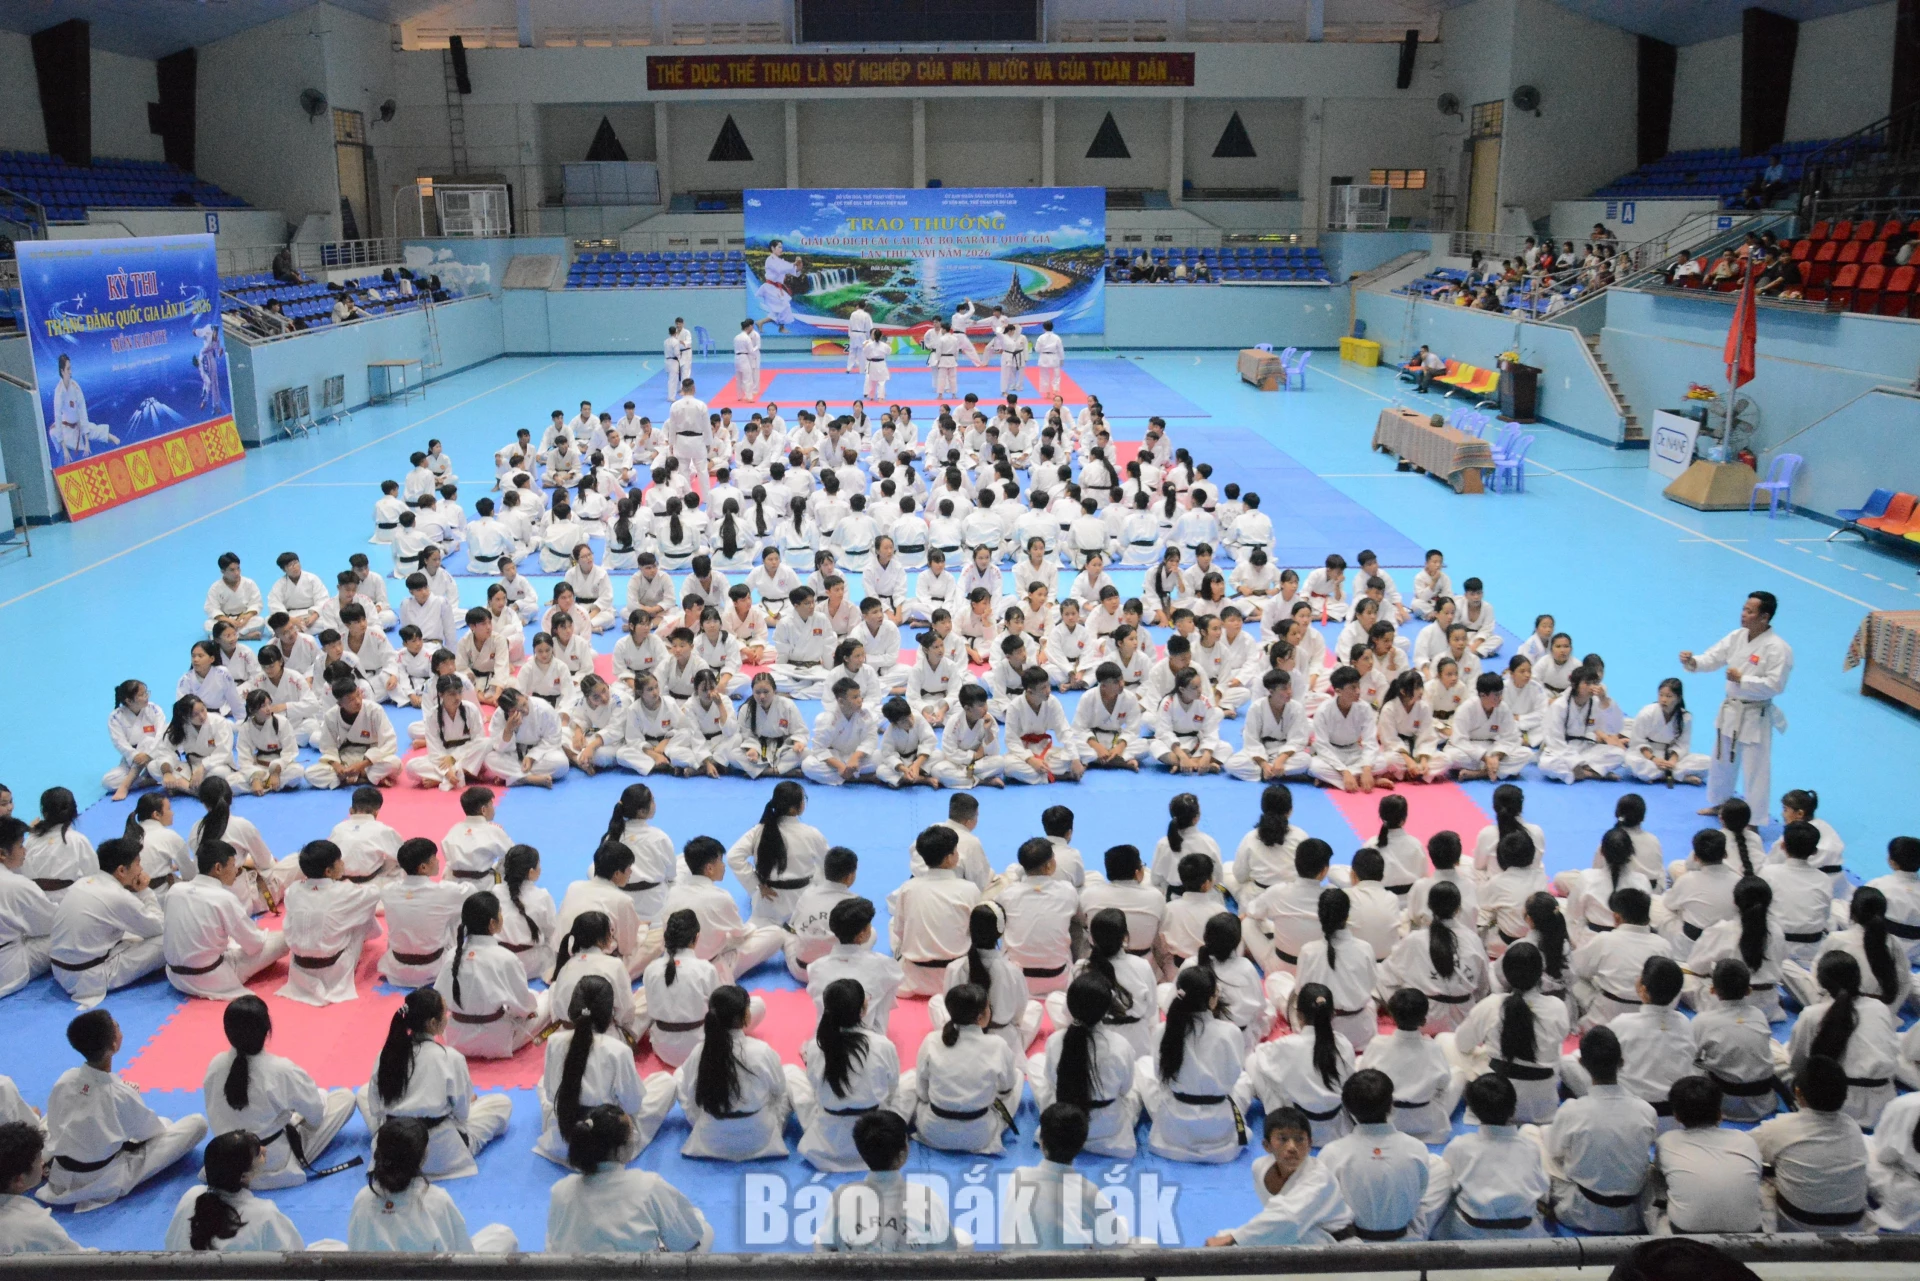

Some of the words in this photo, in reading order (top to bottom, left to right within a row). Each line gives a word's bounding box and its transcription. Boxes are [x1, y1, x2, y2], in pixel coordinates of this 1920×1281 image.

[762, 63, 800, 83] THAO
[807, 59, 827, 82] LÀ
[833, 60, 856, 85] SỰ
[860, 58, 911, 84] NGHIỆP
[917, 57, 946, 80] CỦA
[952, 58, 982, 81] NHÀ
[988, 58, 1028, 81] NƯỚC
[1034, 58, 1053, 80] VÀ
[1059, 56, 1087, 80] CỦA
[1093, 56, 1130, 80] TOÀN
[1623, 204, 1632, 221] A
[208, 215, 217, 232] B
[845, 217, 905, 231] TRAO
[909, 213, 1006, 231] THƯỞNG
[801, 235, 823, 246] GIẢI
[871, 235, 890, 246] CÁC
[917, 236, 935, 247] LẠC
[938, 235, 953, 246] BỘ
[956, 235, 998, 245] KARATE
[1001, 233, 1030, 245] QUỐC
[1032, 235, 1051, 244] GIA
[911, 249, 935, 258] XXVI
[938, 247, 962, 258] NĂM
[965, 249, 991, 257] 2026
[107, 266, 129, 300] KỲ
[130, 271, 158, 297] THI
[45, 313, 86, 337] THĂNG
[85, 308, 115, 331] ĐẲNG
[116, 304, 142, 330] QUỐC
[143, 306, 160, 322] GIA
[161, 299, 179, 320] LẦN
[110, 332, 133, 354] MÔN
[134, 329, 168, 350] KARATE
